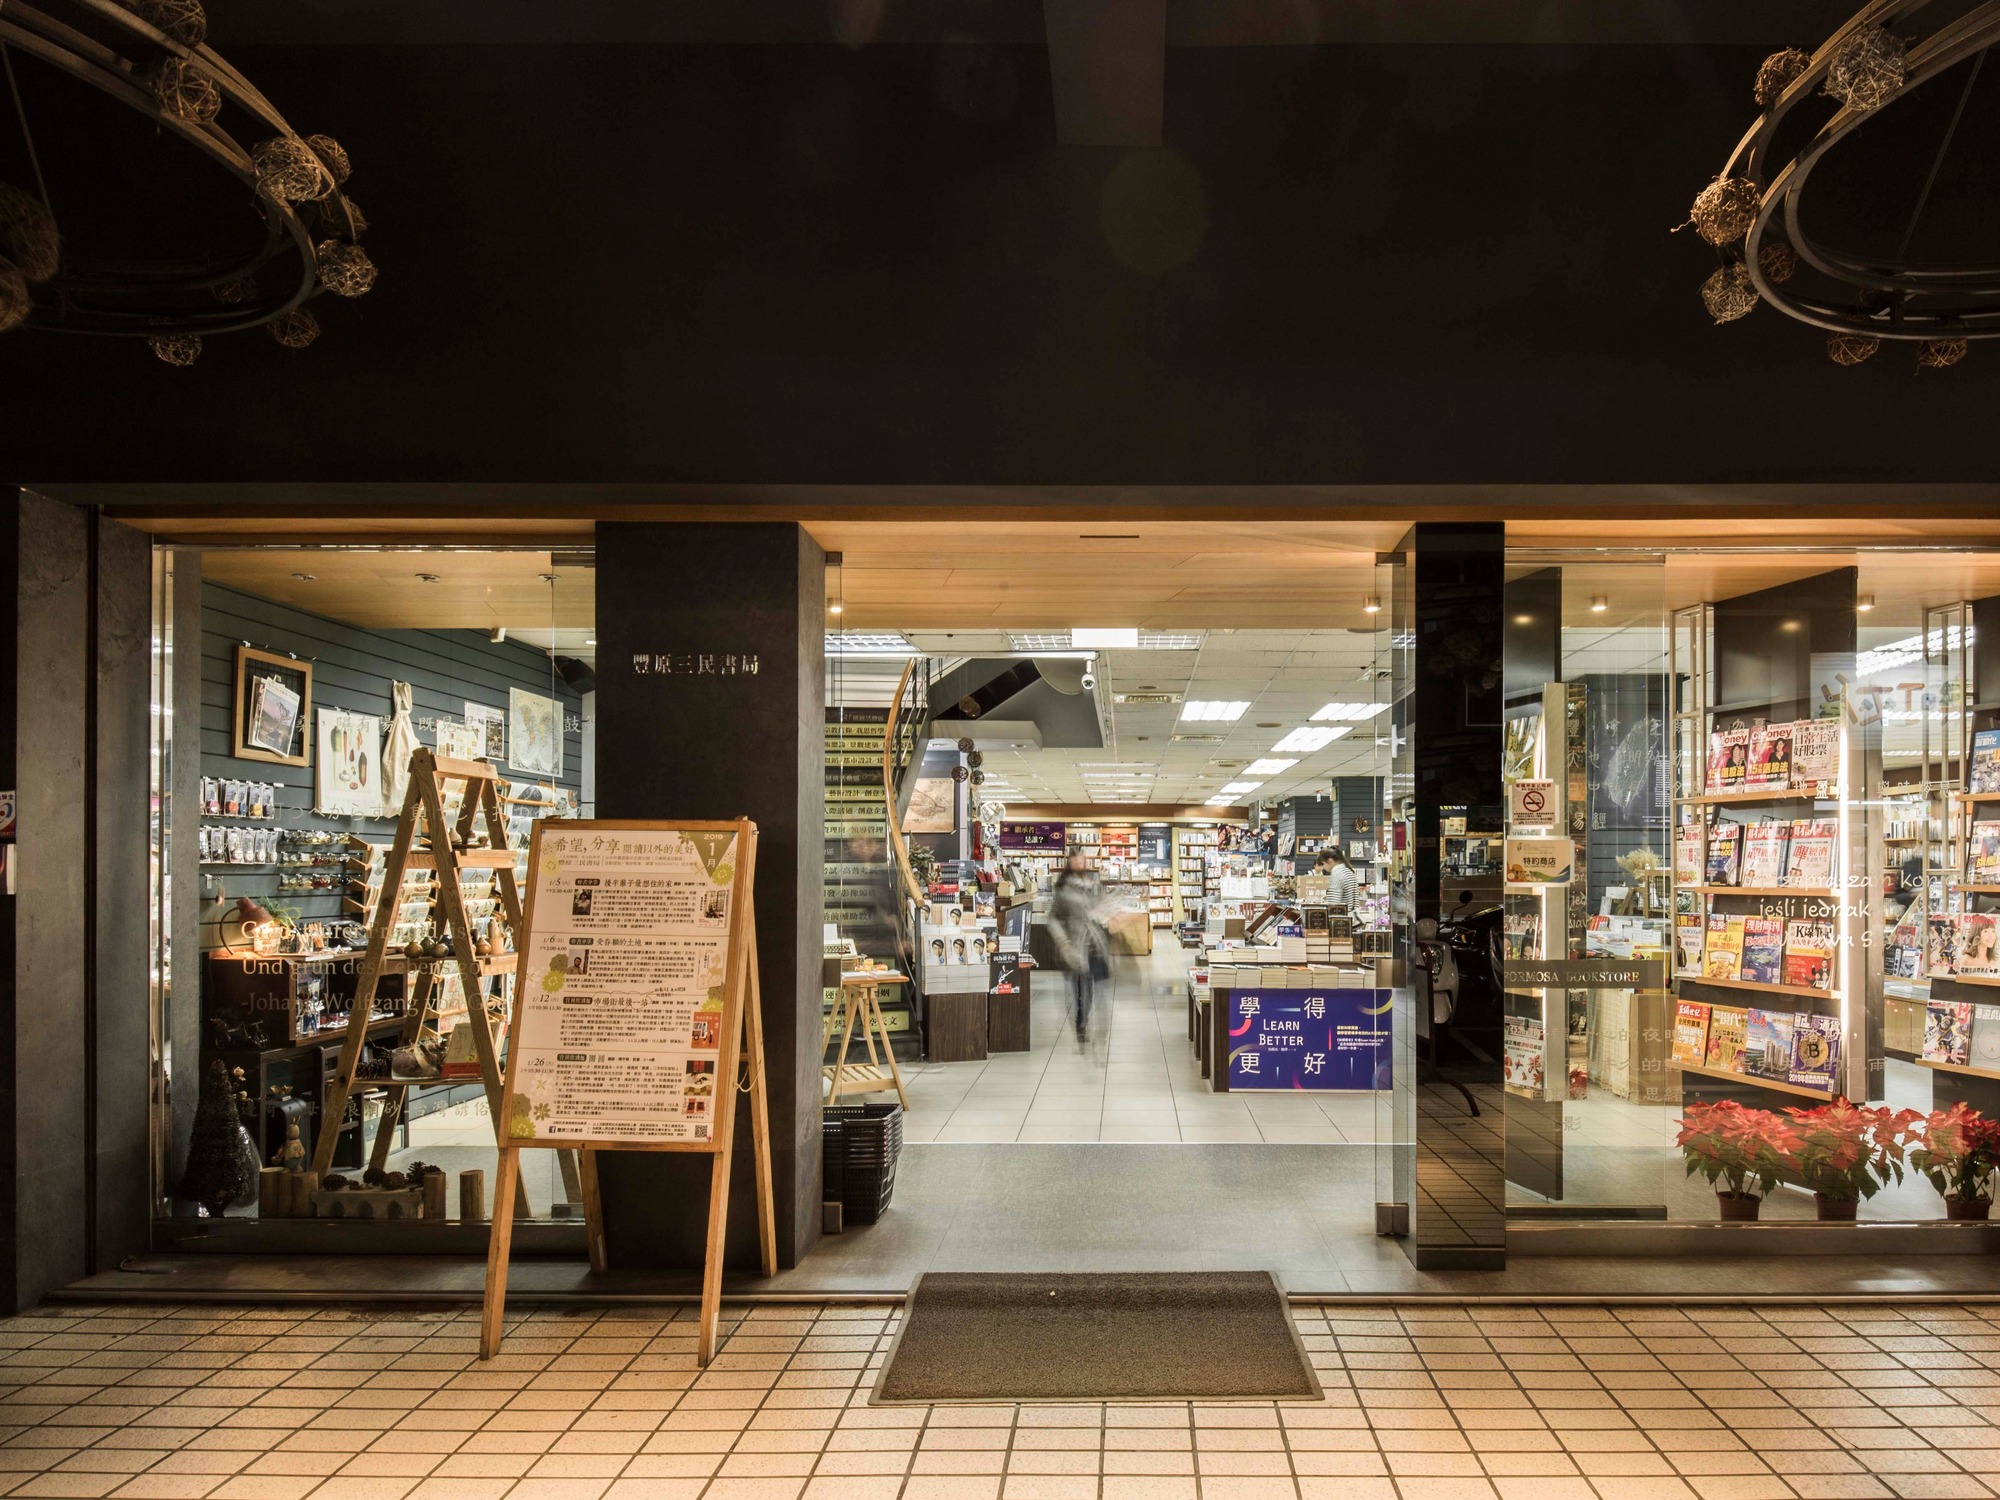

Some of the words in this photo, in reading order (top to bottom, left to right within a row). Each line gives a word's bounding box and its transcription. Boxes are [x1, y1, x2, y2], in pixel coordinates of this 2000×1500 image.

[632, 653, 759, 675] 豐原三民書局
[1714, 827, 1739, 839] Sart
[554, 835, 620, 854] 希望,分享
[623, 843, 694, 855] 閱讀以外的美好
[709, 842, 715, 857] 1
[707, 859, 716, 868] 月
[1523, 857, 1556, 865] 特約商店
[1760, 898, 1795, 917] jeśli
[1746, 919, 1780, 932] 理財周刊
[597, 938, 642, 947] 受眷顧的土地
[243, 957, 284, 975] Und
[291, 957, 337, 981] grün
[343, 957, 376, 975] des
[1504, 970, 1559, 982] FORMOSA
[1566, 970, 1640, 983] BOOKSTORE
[323, 992, 419, 1016] Wolfgang
[1239, 997, 1260, 1019] 學
[1304, 997, 1326, 1019] 得
[1263, 1019, 1300, 1031] LEARN
[1259, 1034, 1304, 1046] BETTER
[1239, 1053, 1261, 1074] 更
[1304, 1053, 1326, 1075] 好
